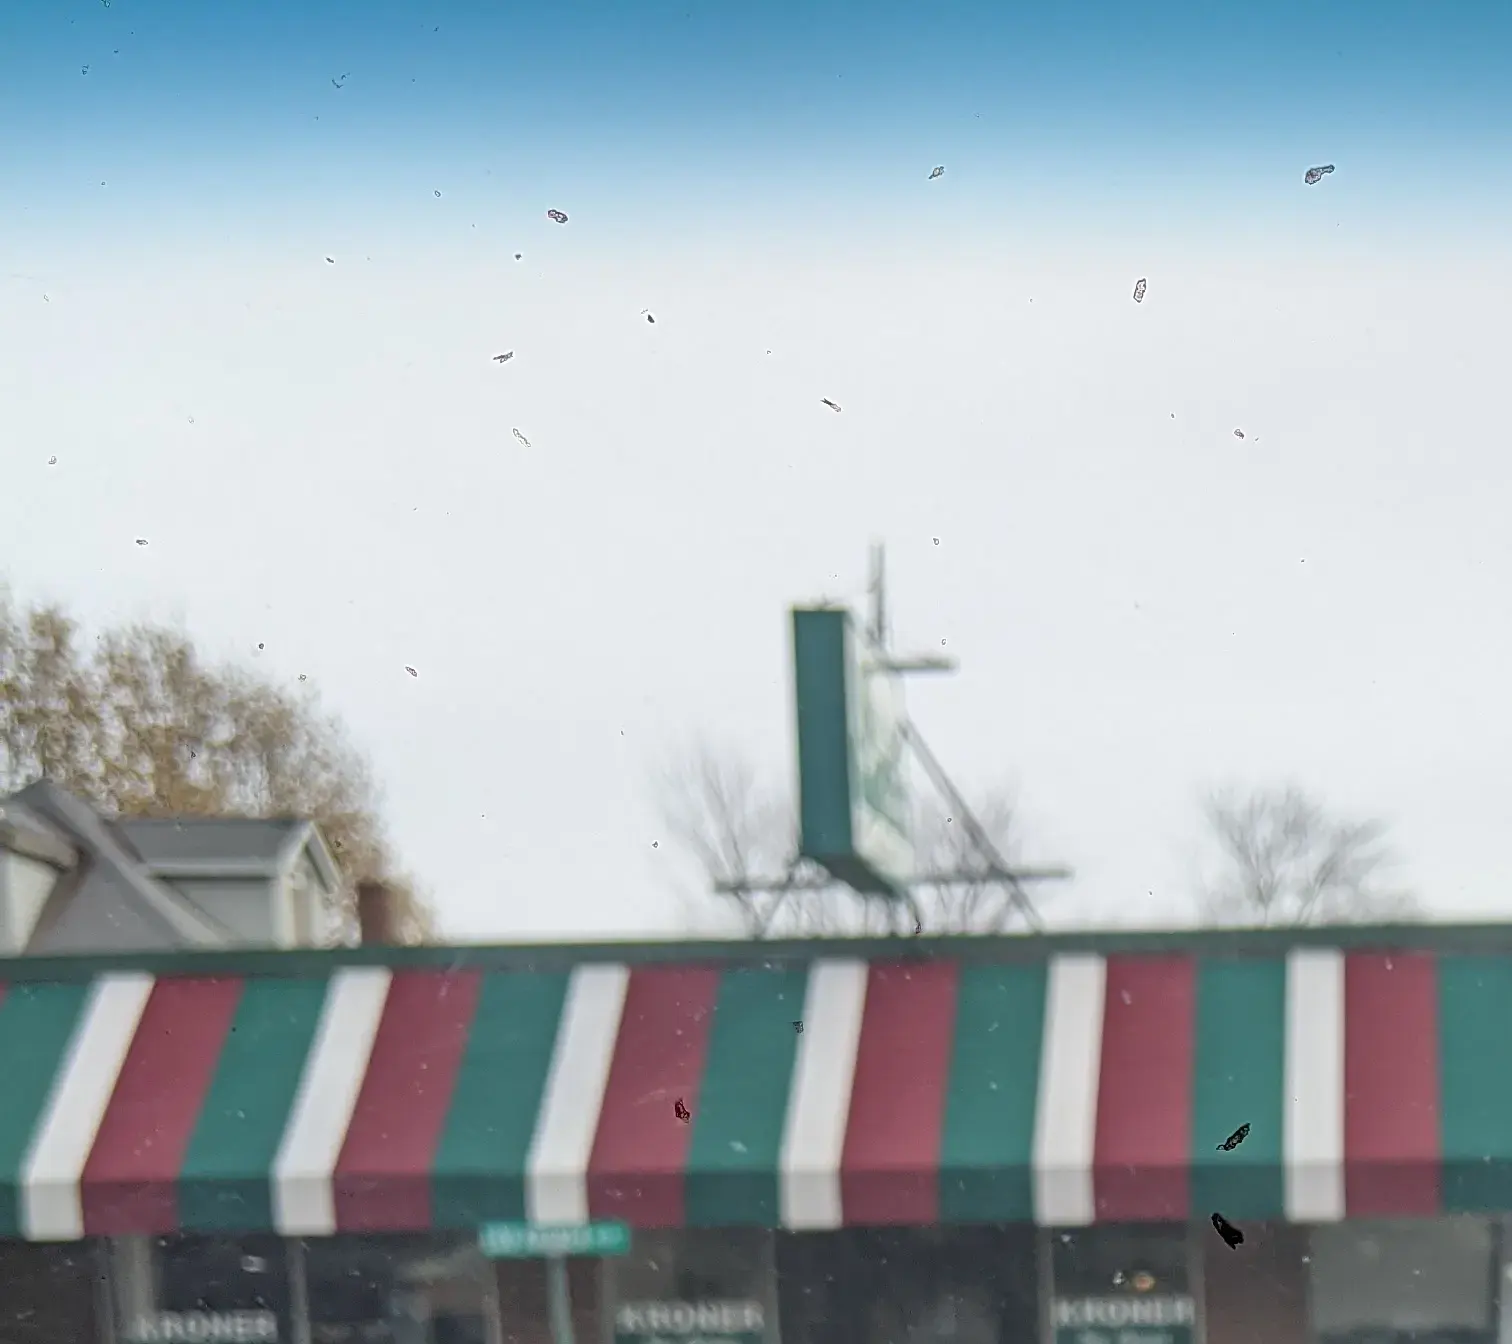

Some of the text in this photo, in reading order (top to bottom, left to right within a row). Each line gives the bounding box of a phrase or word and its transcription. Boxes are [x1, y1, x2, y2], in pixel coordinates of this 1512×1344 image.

[134, 1310, 278, 1343] KRONER
[616, 1301, 764, 1333] KRONER
[1054, 1296, 1196, 1326] KRONER
